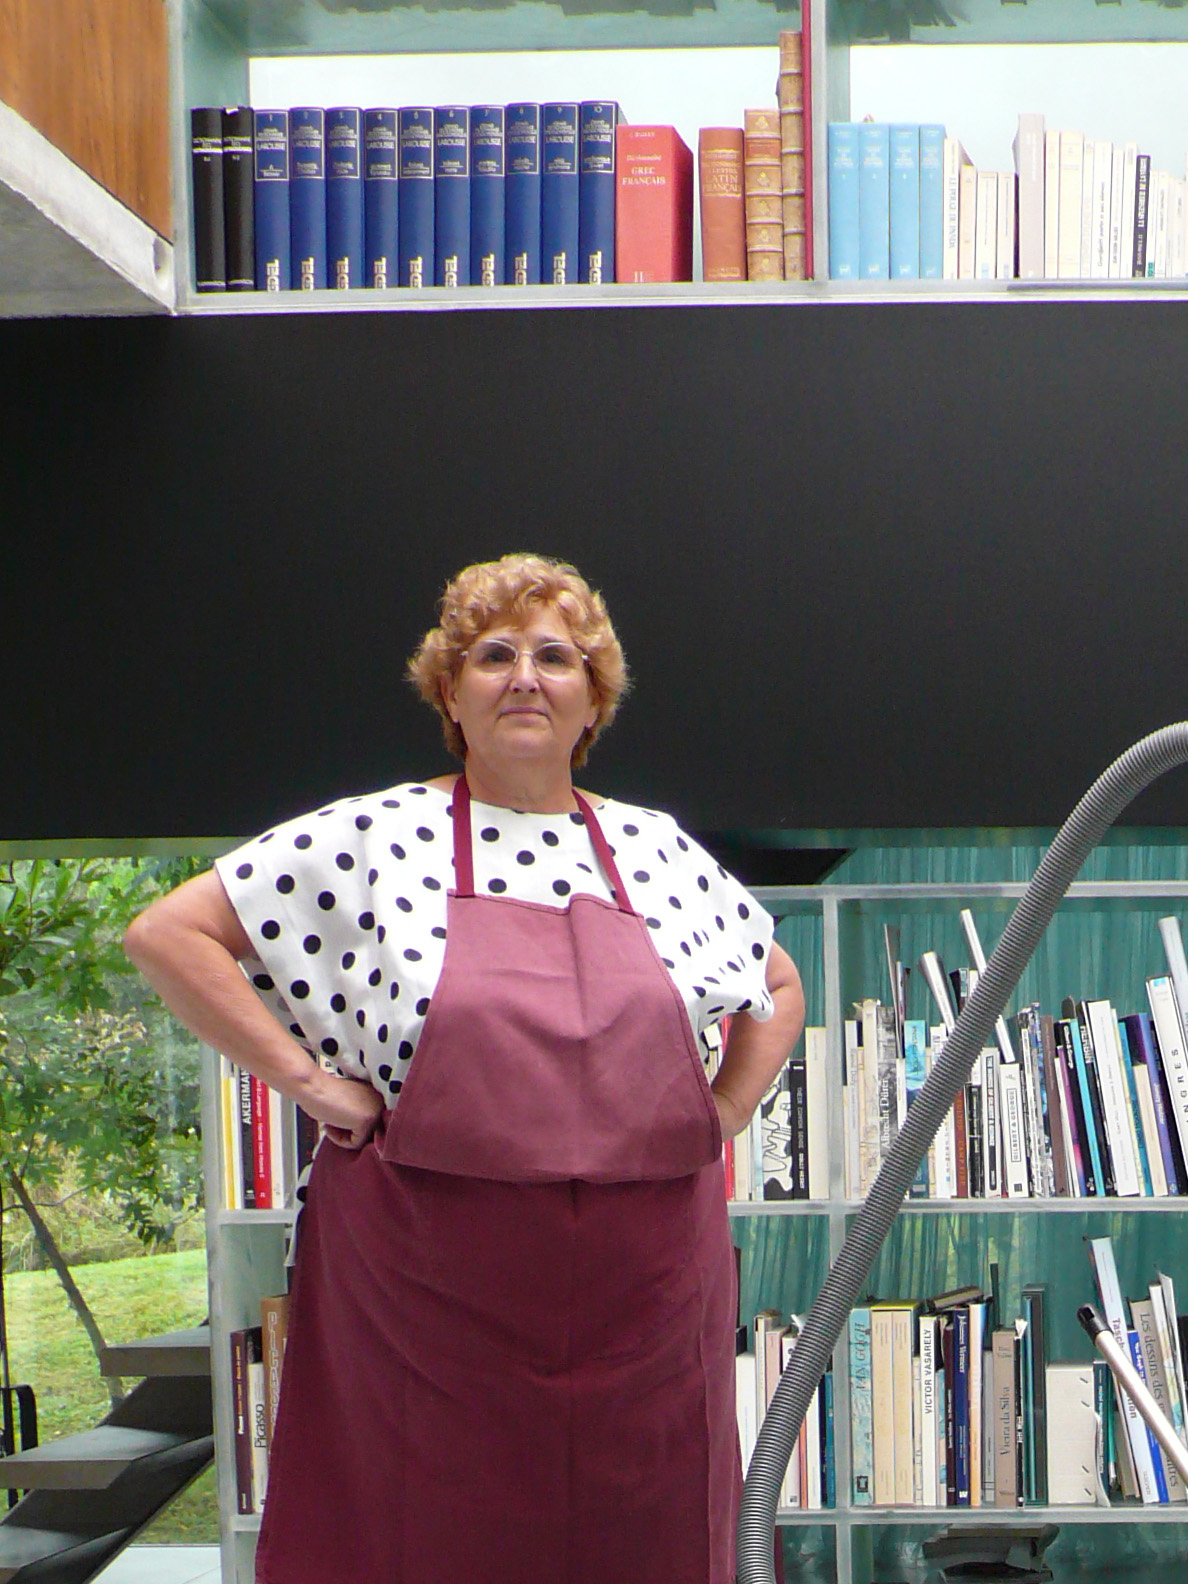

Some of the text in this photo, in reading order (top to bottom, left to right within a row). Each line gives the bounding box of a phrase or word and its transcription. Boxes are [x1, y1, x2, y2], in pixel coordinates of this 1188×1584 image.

[622, 175, 666, 186] FRANÇAIS
[631, 167, 656, 175] GREC
[1079, 1025, 1093, 1064] HERBIN
[850, 1070, 858, 1087] Dufy
[879, 1078, 890, 1148] Albrecht Dürer
[1153, 1083, 1166, 1125] Jenny Holzer
[957, 1314, 966, 1345] Johannes
[1139, 1313, 1152, 1332] Les
[854, 1322, 867, 1390] VAN GOGH
[923, 1329, 932, 1414] VICTOR VASARELY
[1144, 1336, 1161, 1377] dessins
[1151, 1380, 1164, 1400] des
[253, 1404, 266, 1448] Picasso
[999, 1386, 1011, 1456] Vieira da Silva
